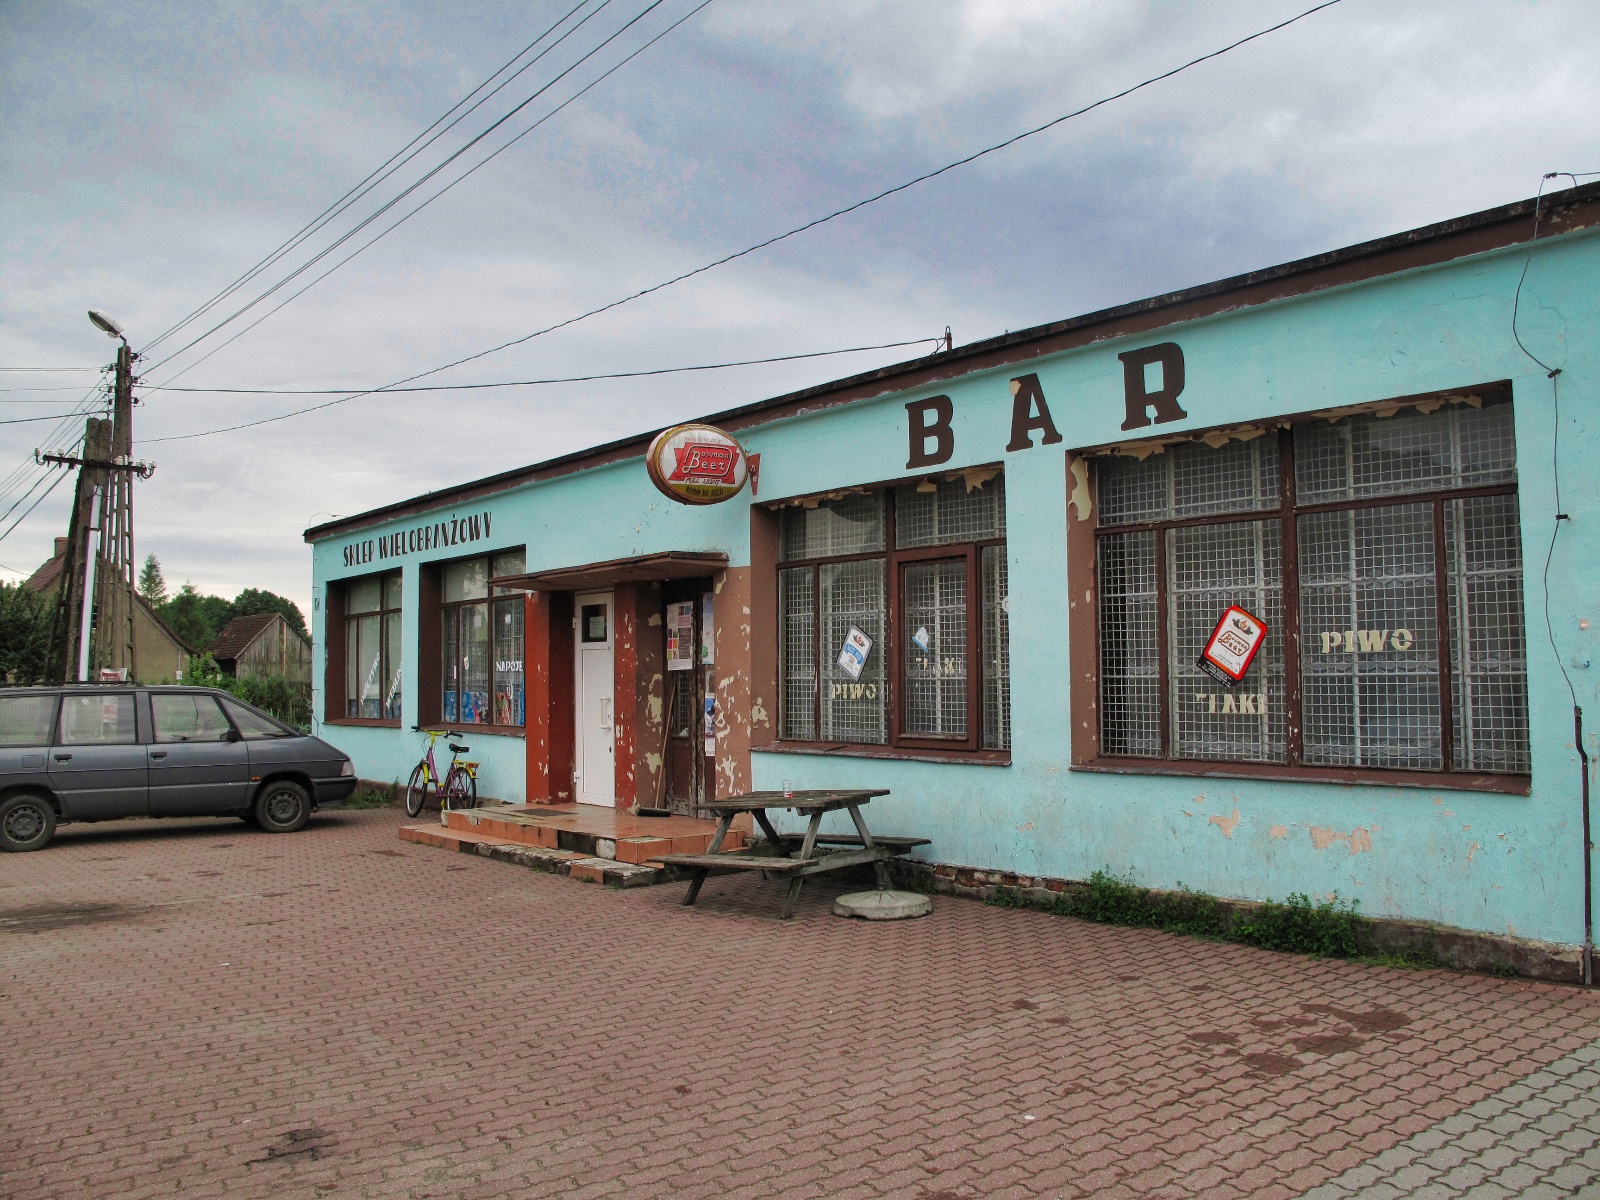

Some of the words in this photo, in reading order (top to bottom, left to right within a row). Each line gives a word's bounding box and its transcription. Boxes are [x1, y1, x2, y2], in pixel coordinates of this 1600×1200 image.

[904, 342, 1188, 470] BAR
[682, 452, 726, 473] Beer
[343, 539, 375, 567] SKLEP
[378, 511, 492, 560] WIELOBRANŻOWY
[1321, 628, 1413, 654] PIWO
[495, 660, 524, 672] NAPOJE
